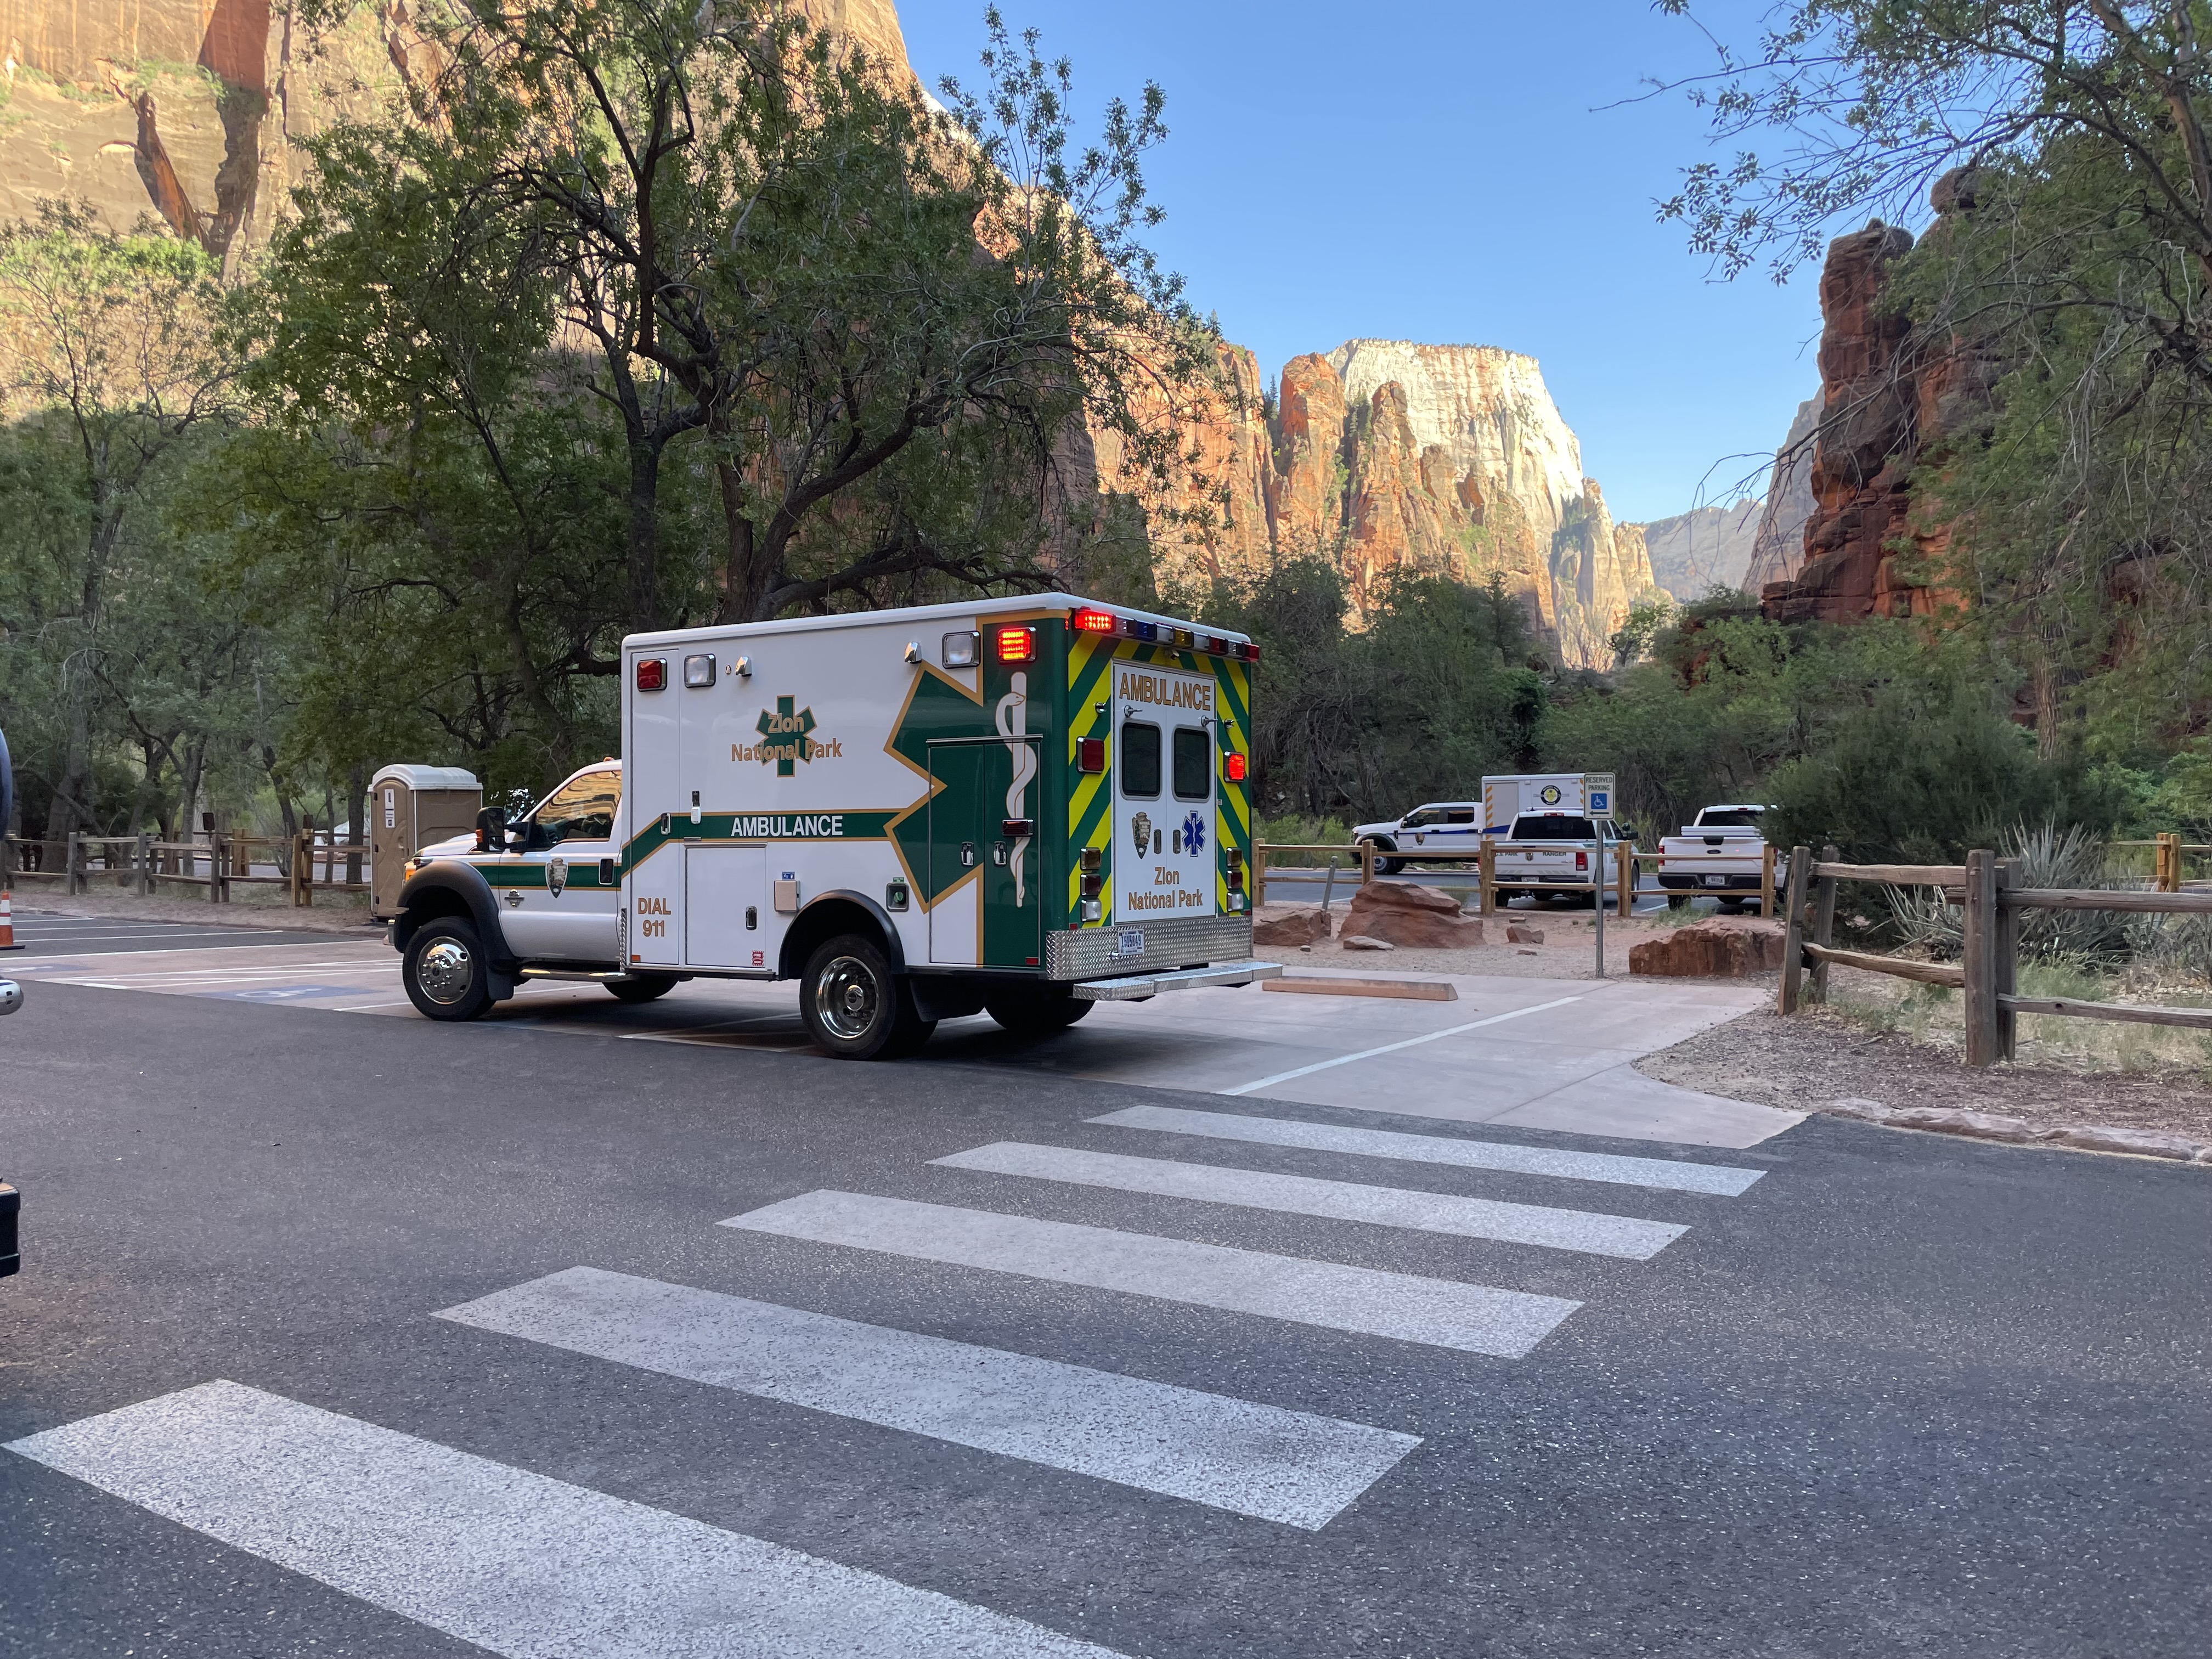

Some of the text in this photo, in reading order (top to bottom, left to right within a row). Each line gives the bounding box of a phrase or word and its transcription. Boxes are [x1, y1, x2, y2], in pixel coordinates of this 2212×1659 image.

[1119, 673, 1211, 711] AMBULANCE
[768, 713, 804, 733] Zion
[731, 737, 843, 761] National Park
[731, 815, 843, 837] AMBULANCE
[1154, 867, 1180, 885] Zion
[638, 898, 672, 915] DIAL
[1128, 889, 1203, 910] National Park
[642, 919, 665, 937] 911
